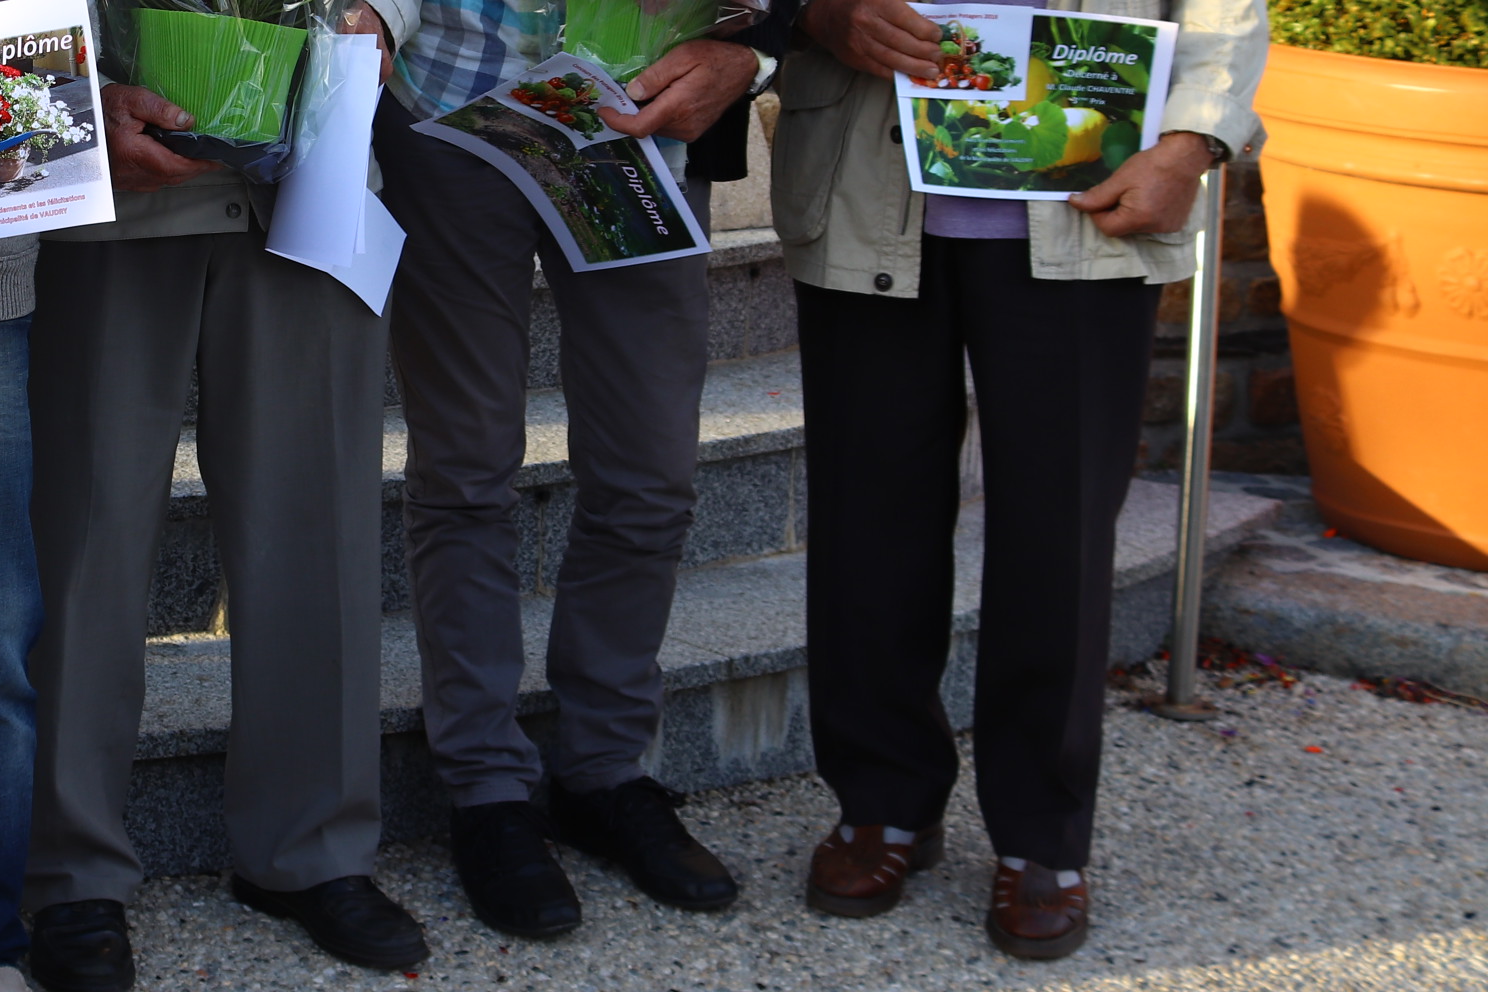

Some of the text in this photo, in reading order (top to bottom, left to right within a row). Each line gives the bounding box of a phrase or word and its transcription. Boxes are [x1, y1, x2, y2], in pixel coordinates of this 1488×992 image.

[1052, 44, 1138, 65] Diplôme
[47, 194, 86, 206] félicitations
[622, 166, 669, 236] Diplôme
[29, 212, 38, 220] de
[38, 208, 68, 218] VAUDRY
